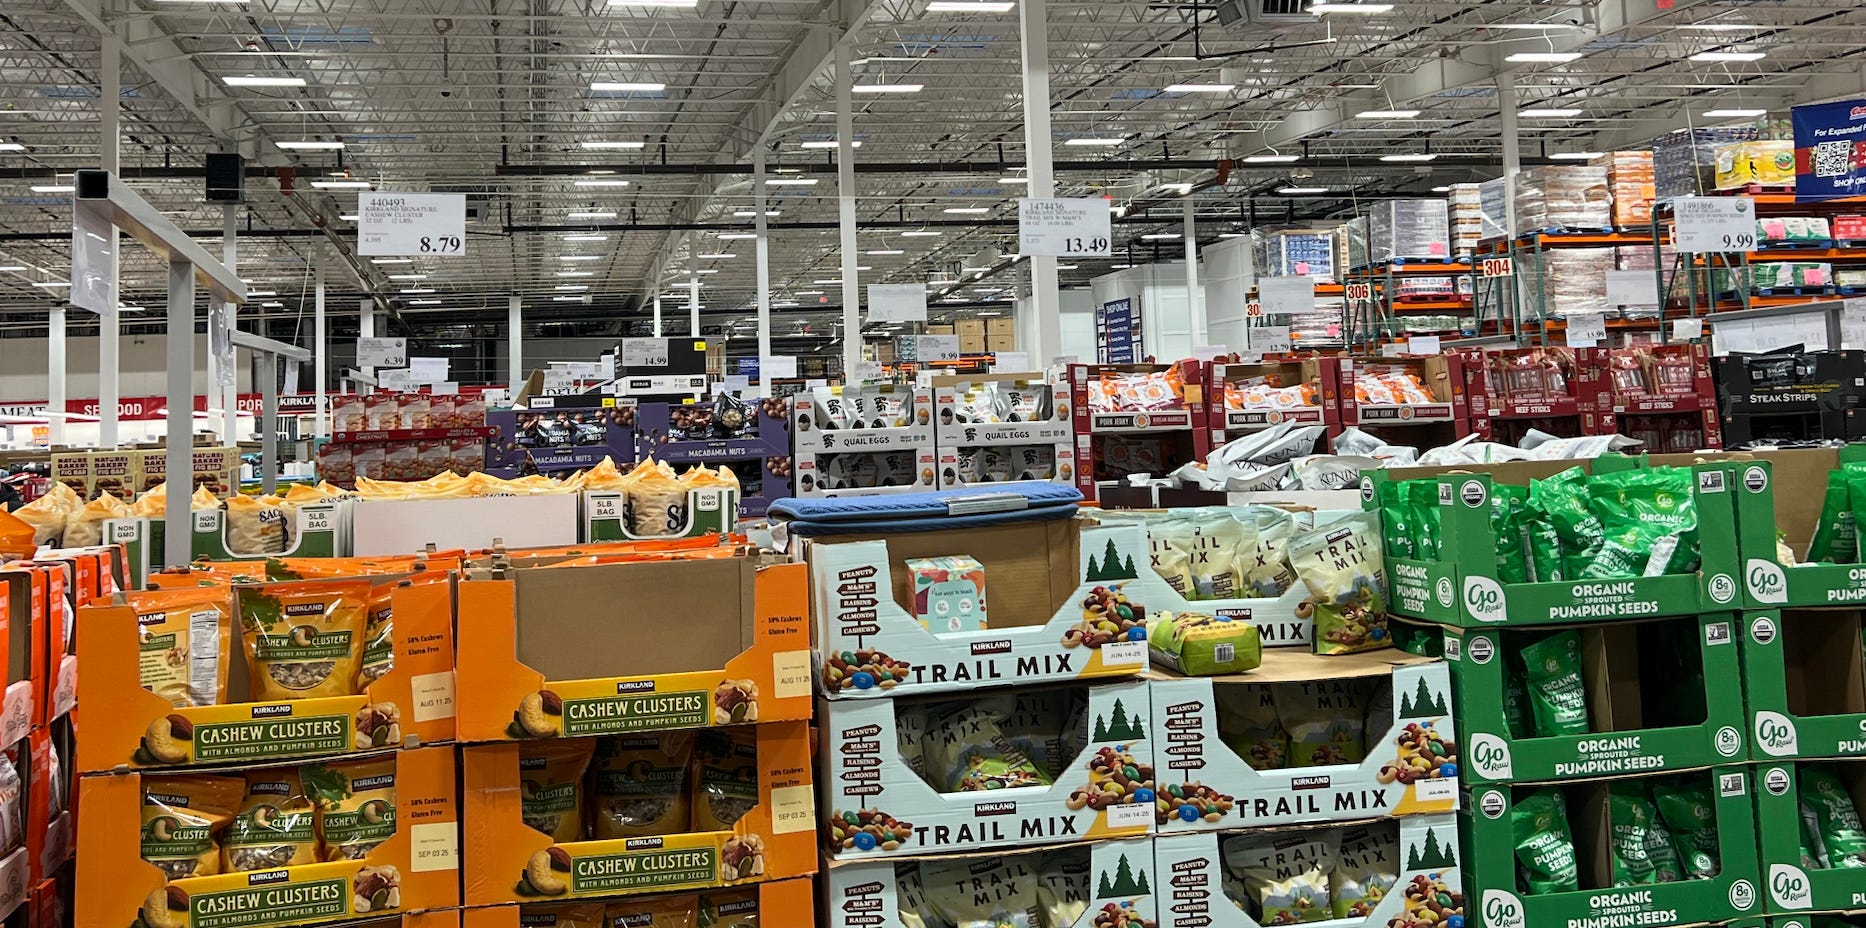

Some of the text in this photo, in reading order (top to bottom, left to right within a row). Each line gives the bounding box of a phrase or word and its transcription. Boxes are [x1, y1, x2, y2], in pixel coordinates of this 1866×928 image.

[1814, 129, 1827, 137] For
[1828, 124, 1863, 136] Expanded
[1833, 178, 1854, 188] SHOP
[370, 198, 405, 207] 440493
[1030, 202, 1065, 210] 1474436
[420, 236, 460, 253] 8.79
[1065, 237, 1108, 253] 13.49
[1723, 234, 1753, 248] 9.99
[1485, 259, 1510, 276] 304
[1347, 285, 1369, 299] 306
[1270, 344, 1289, 352] 12.79
[384, 357, 404, 366] 6.39
[644, 357, 667, 365] 14.99
[941, 352, 958, 360] 9.99
[1750, 393, 1817, 403] STEAK STRIPS
[238, 399, 263, 412] POR
[1515, 406, 1530, 414] BEEF
[1639, 402, 1653, 410] BEEF
[1366, 410, 1379, 418] PORK
[1379, 409, 1394, 418] JERKY
[1099, 417, 1114, 425] PORK
[1114, 417, 1129, 425] JERKY
[843, 436, 890, 447] QUAIL EGGS
[985, 431, 1030, 441] QUAIL EGGS
[688, 447, 746, 457] MACADAMIA NUTS
[535, 454, 592, 464] MACADAMIA NUTS
[596, 508, 615, 516] BAG
[308, 520, 328, 528] BAG
[117, 531, 135, 539] GMO
[1315, 535, 1367, 561] TRAIL
[1334, 551, 1366, 571] MIX
[1396, 585, 1431, 601] PUMPKIN
[1571, 582, 1635, 597] ORGANIC
[1403, 598, 1425, 613] SEEDS
[1584, 596, 1623, 604] SPROUTED
[1549, 600, 1659, 619] PUMPKIN SEEDS
[780, 614, 802, 623] Cashews
[785, 626, 798, 634] Free
[1258, 622, 1304, 640] MIX
[408, 645, 439, 657] Gluten Free
[911, 653, 1073, 684] TRAIL MIX
[618, 680, 654, 690] KIRKLAND
[780, 675, 811, 685] AUG 11 25
[419, 697, 452, 708] AUG 11 25
[569, 695, 701, 719] CASHEW CLUSTERS
[1169, 703, 1200, 713] PEANUTS
[253, 705, 291, 715] KIRKLAND
[570, 715, 701, 732] WITH ALMONDS AND PUMPKIN SEEDS
[200, 719, 342, 744] CASHEW CLUSTERS
[845, 727, 878, 738] PEANUTS
[1171, 733, 1199, 741] RAISINS
[201, 740, 342, 757] WITH ALMONDS AND PUMPKIN SEEDS
[1577, 735, 1641, 753] ORGANIC
[1169, 746, 1201, 754] ALMONDS
[1590, 750, 1629, 760] SPROUTED
[846, 758, 876, 766] RAISINS
[1170, 759, 1202, 768] CASHEWS
[1555, 754, 1665, 776] PUMPKIN SEEDS
[783, 767, 804, 776] Cashews
[844, 771, 878, 780] ALMONDS
[535, 786, 574, 800] CLUSTERS
[846, 785, 879, 794] CASHEWS
[410, 796, 448, 807] 50% Cashews
[1235, 789, 1387, 819] TRAIL MIX
[324, 816, 359, 827] CASHEW
[778, 811, 807, 821] SEP 03 25
[914, 815, 1077, 846] TRAIL MIX
[627, 838, 662, 848] KIRKLAND
[418, 848, 449, 859] SEP 03 25
[578, 852, 709, 876] CASHEW CLUSTERS
[1547, 854, 1573, 872] SEEDS
[250, 870, 289, 881] KIRKLAND
[579, 880, 598, 888] WITH
[600, 878, 634, 887] ALMONDS
[653, 874, 685, 883] PUMPKIN
[687, 871, 709, 880] SEEDS
[955, 865, 1028, 895] TRAIL
[848, 884, 881, 895] PEANUTS
[197, 885, 340, 914] CASHEW CLUSTERS
[973, 885, 1019, 907] MIX
[1589, 891, 1653, 909] ORGANIC
[1174, 903, 1207, 912] ALMONDS
[1602, 906, 1641, 916] SPROUTED
[198, 903, 340, 927] WITH ALMONDS AND PUMPKIN SEEDS
[849, 916, 878, 924] RAISINS
[1567, 909, 1677, 928] PUMPKIN SEEDS
[1176, 918, 1207, 926] CASHEWS
